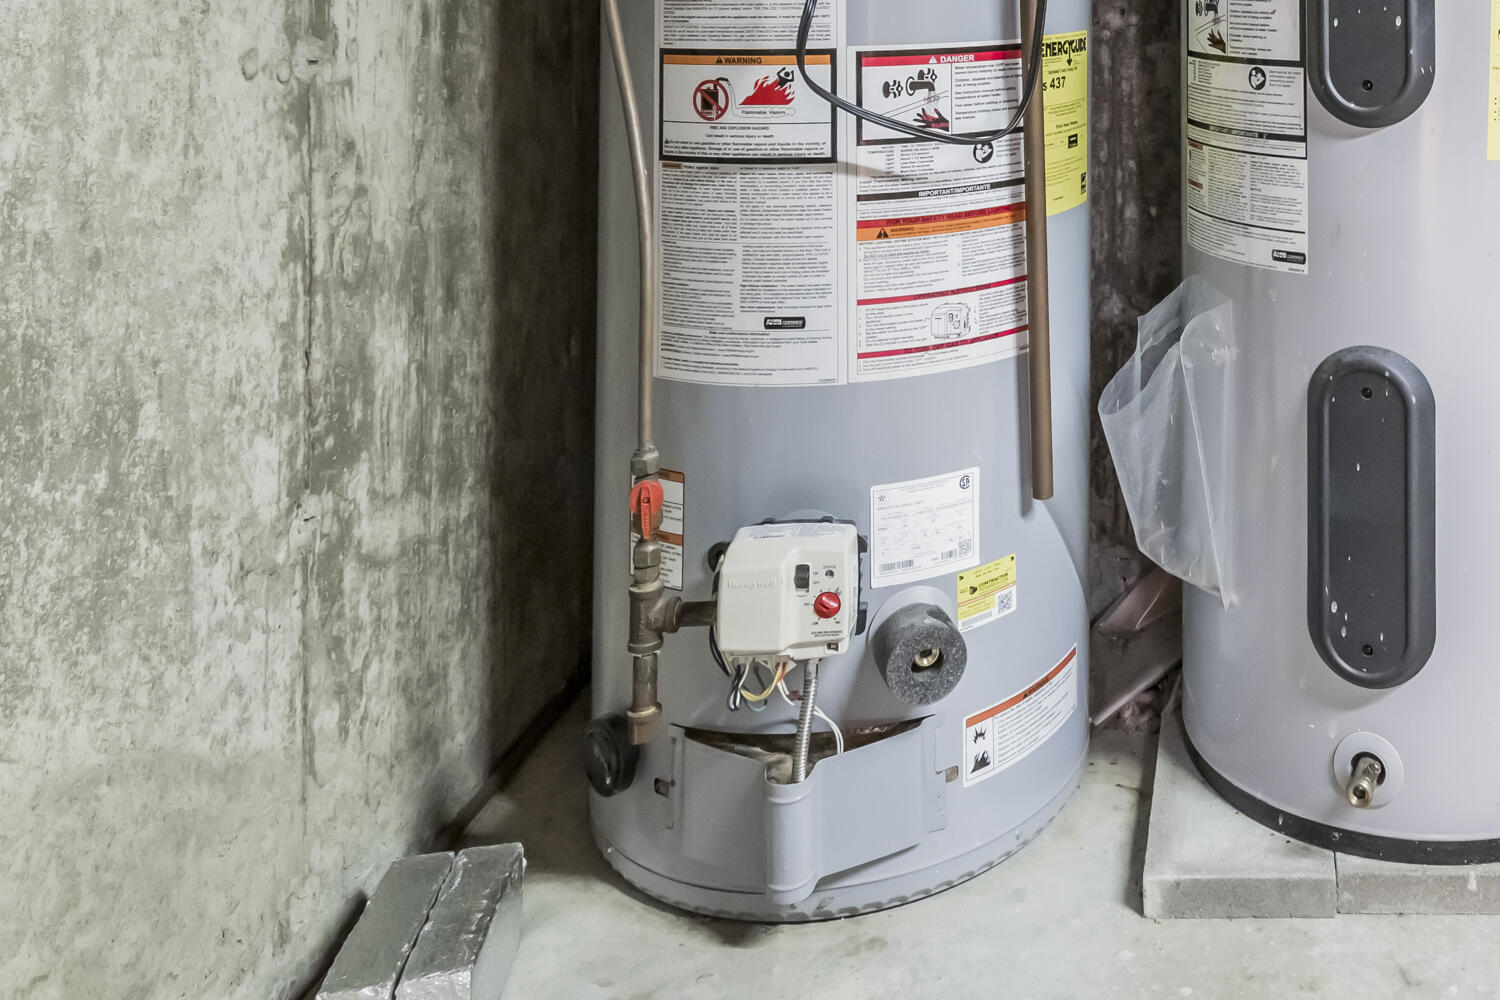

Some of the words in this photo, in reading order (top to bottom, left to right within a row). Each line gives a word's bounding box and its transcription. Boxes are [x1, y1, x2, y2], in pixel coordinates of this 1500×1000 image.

[940, 55, 975, 63] DANGER
[1050, 76, 1066, 89] 437
[727, 579, 776, 592] Honeywell
